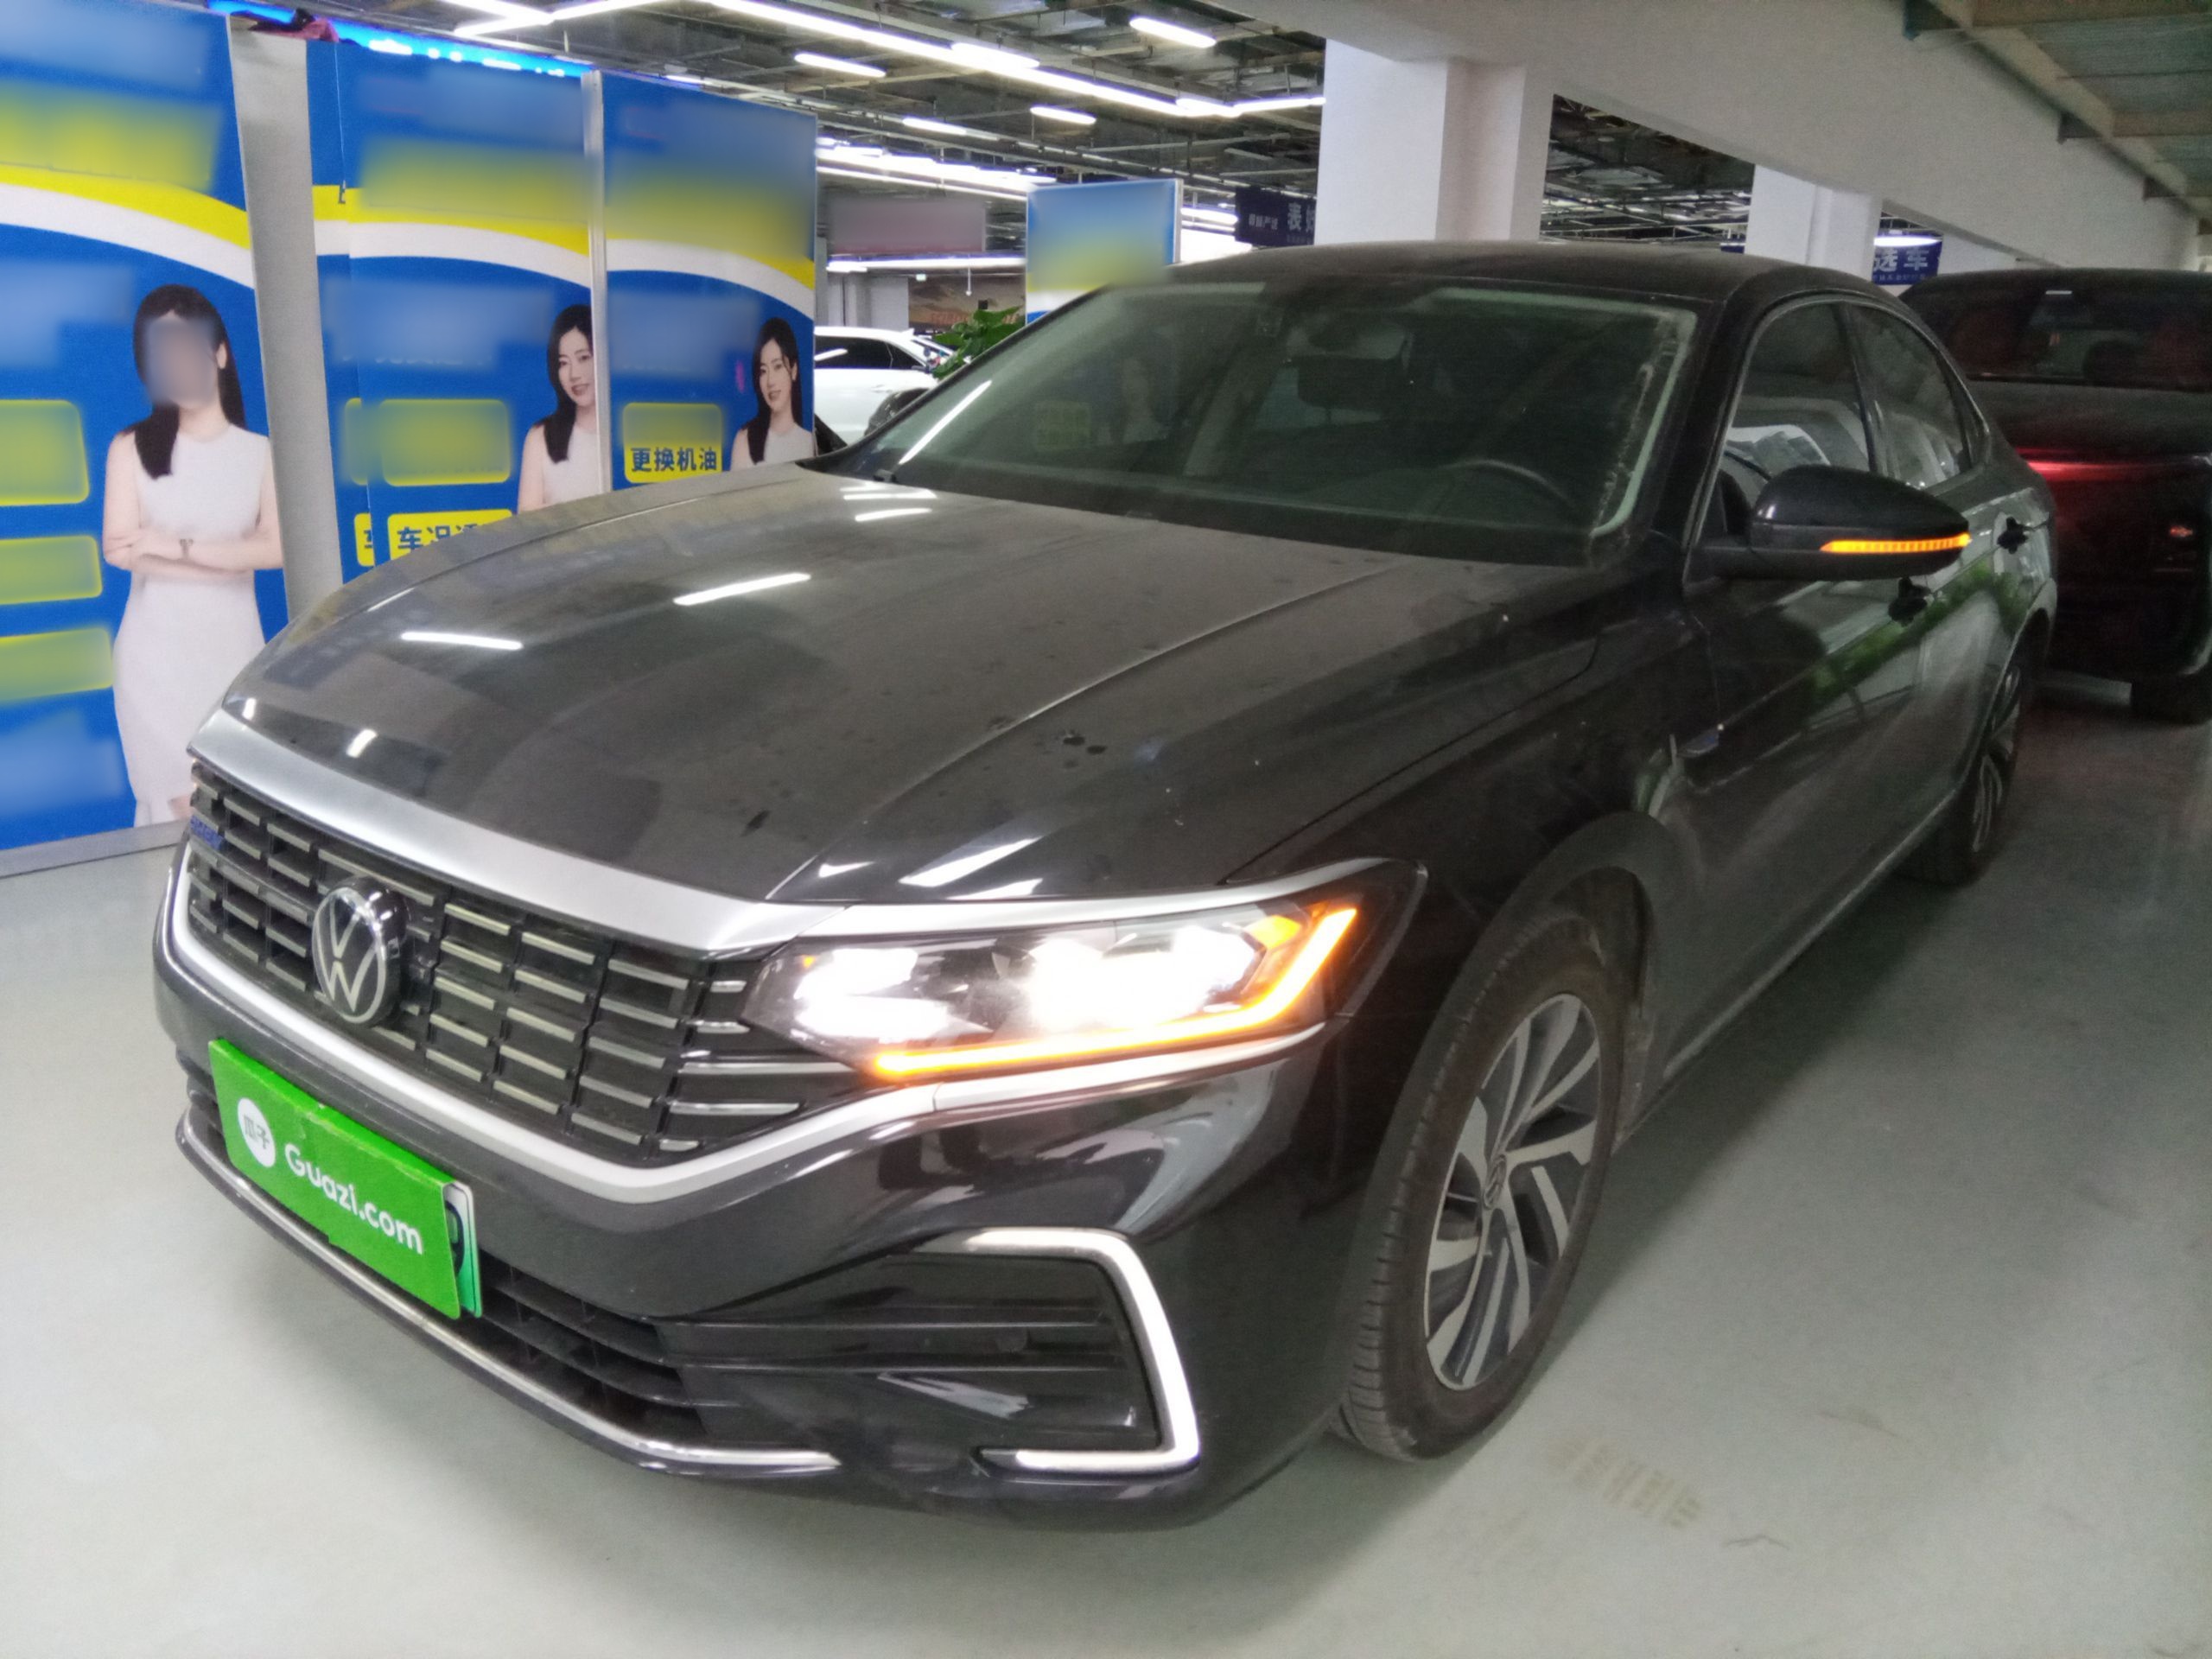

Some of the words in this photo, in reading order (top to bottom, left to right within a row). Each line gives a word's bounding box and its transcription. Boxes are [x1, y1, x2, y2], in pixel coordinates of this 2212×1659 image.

[631, 447, 717, 472] 更换机油
[397, 523, 478, 550] 车况
[284, 1142, 423, 1255] Guazi.com
